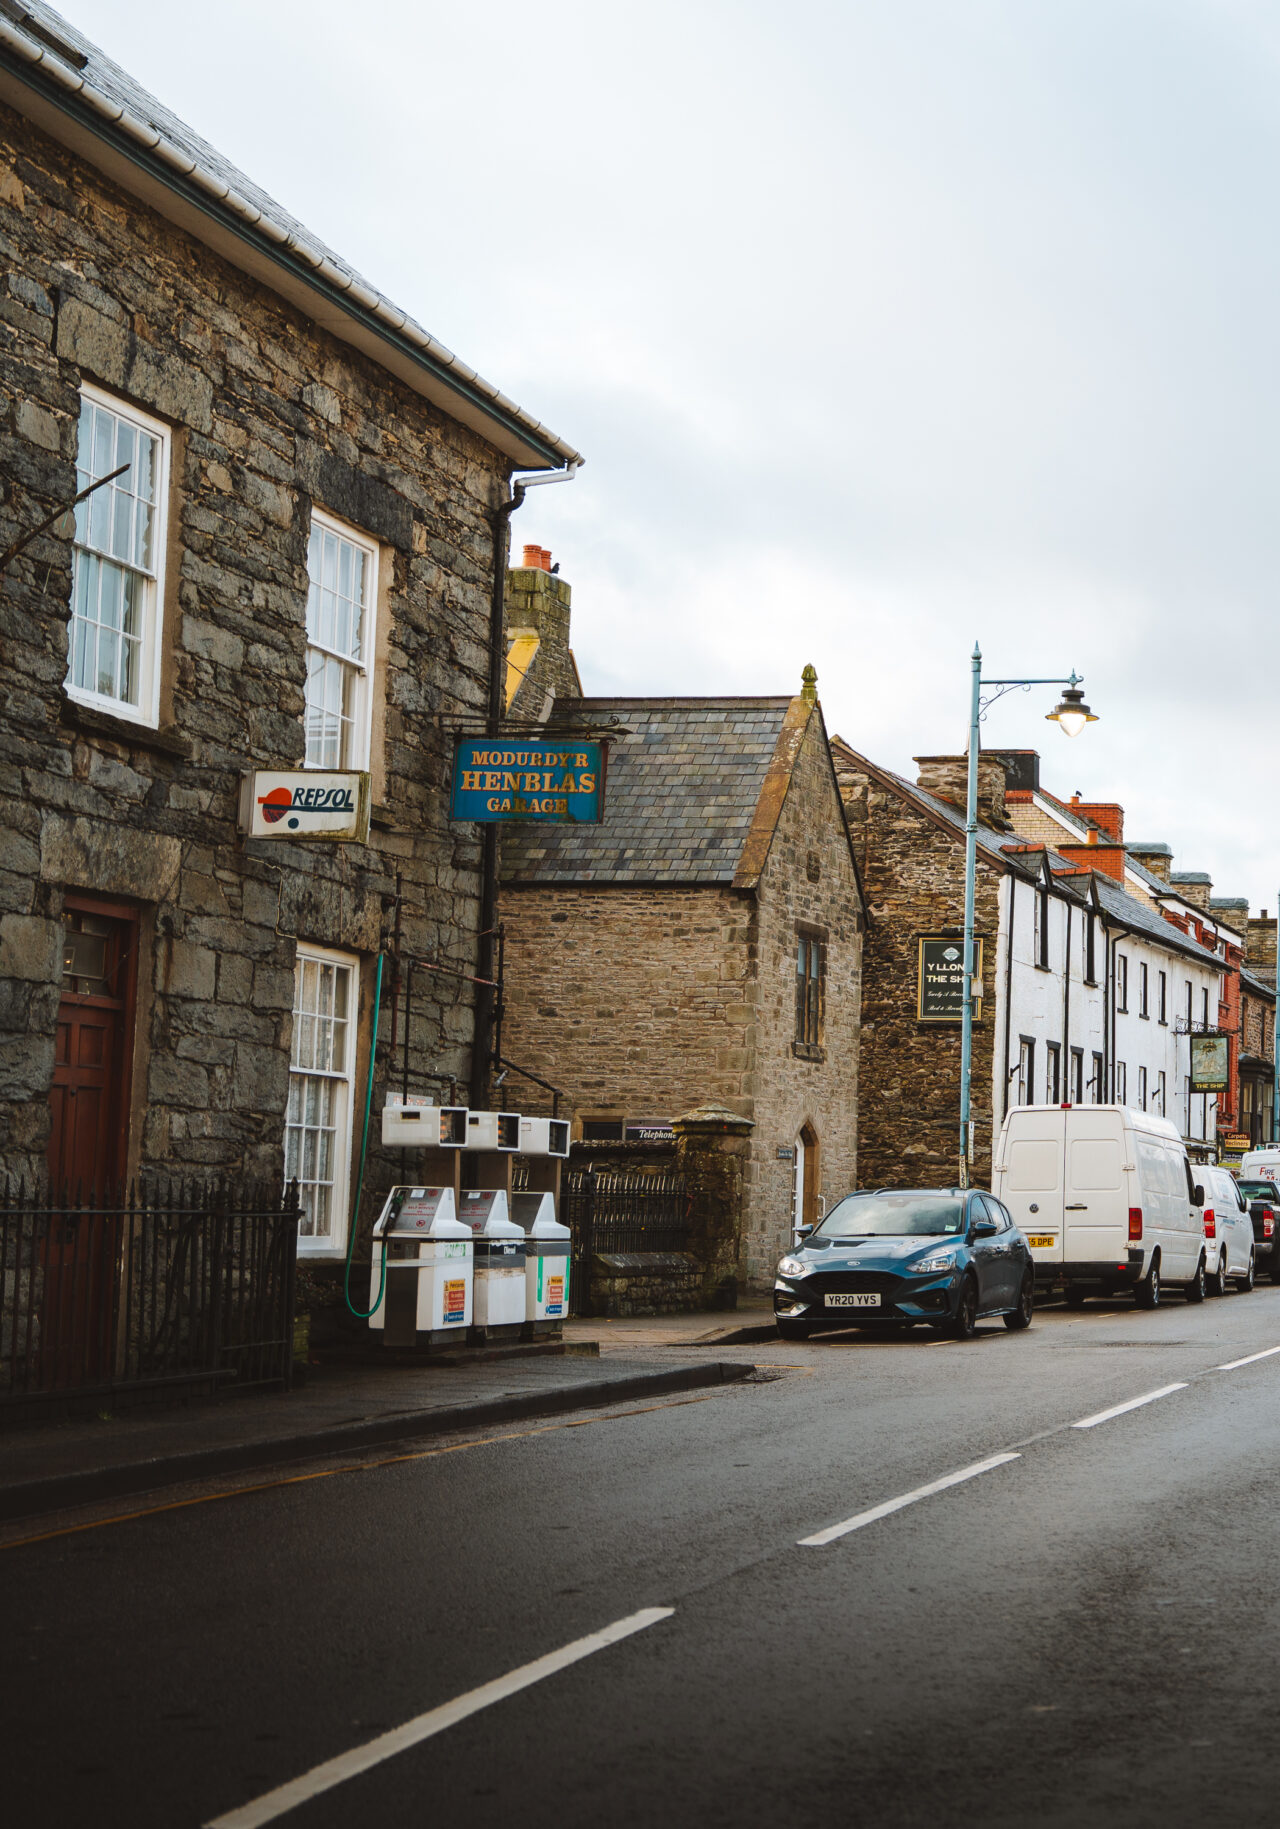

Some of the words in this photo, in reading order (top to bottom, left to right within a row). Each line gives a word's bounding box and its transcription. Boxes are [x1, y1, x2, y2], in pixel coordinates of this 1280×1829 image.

[471, 751, 588, 768] MODURDY'R
[460, 769, 595, 794] HENBLAS
[292, 787, 354, 808] REPSOL
[487, 797, 567, 815] GARAGE
[1037, 1237, 1052, 1246] DPE
[828, 1295, 855, 1305] YR20
[857, 1295, 877, 1305] YVS
